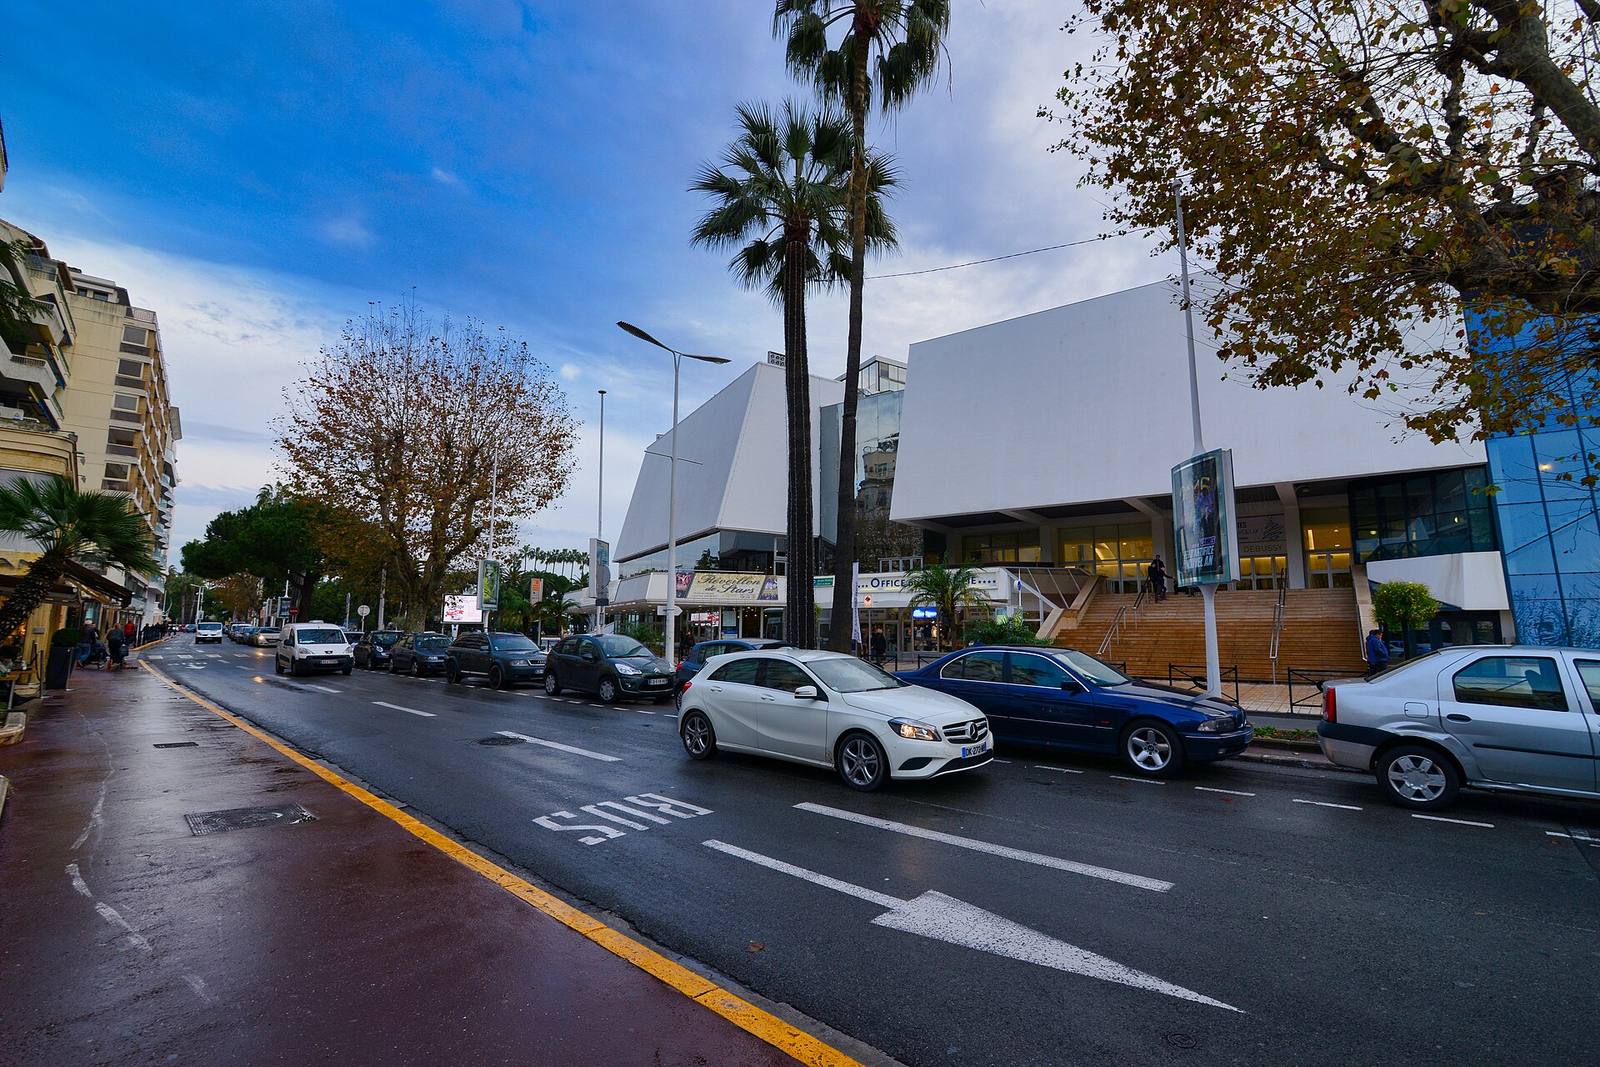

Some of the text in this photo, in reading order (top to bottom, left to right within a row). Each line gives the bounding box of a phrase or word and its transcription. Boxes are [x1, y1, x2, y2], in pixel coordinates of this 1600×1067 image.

[870, 577, 906, 588] OFFICE
[717, 583, 754, 594] Stars
[532, 792, 716, 846] BUS
